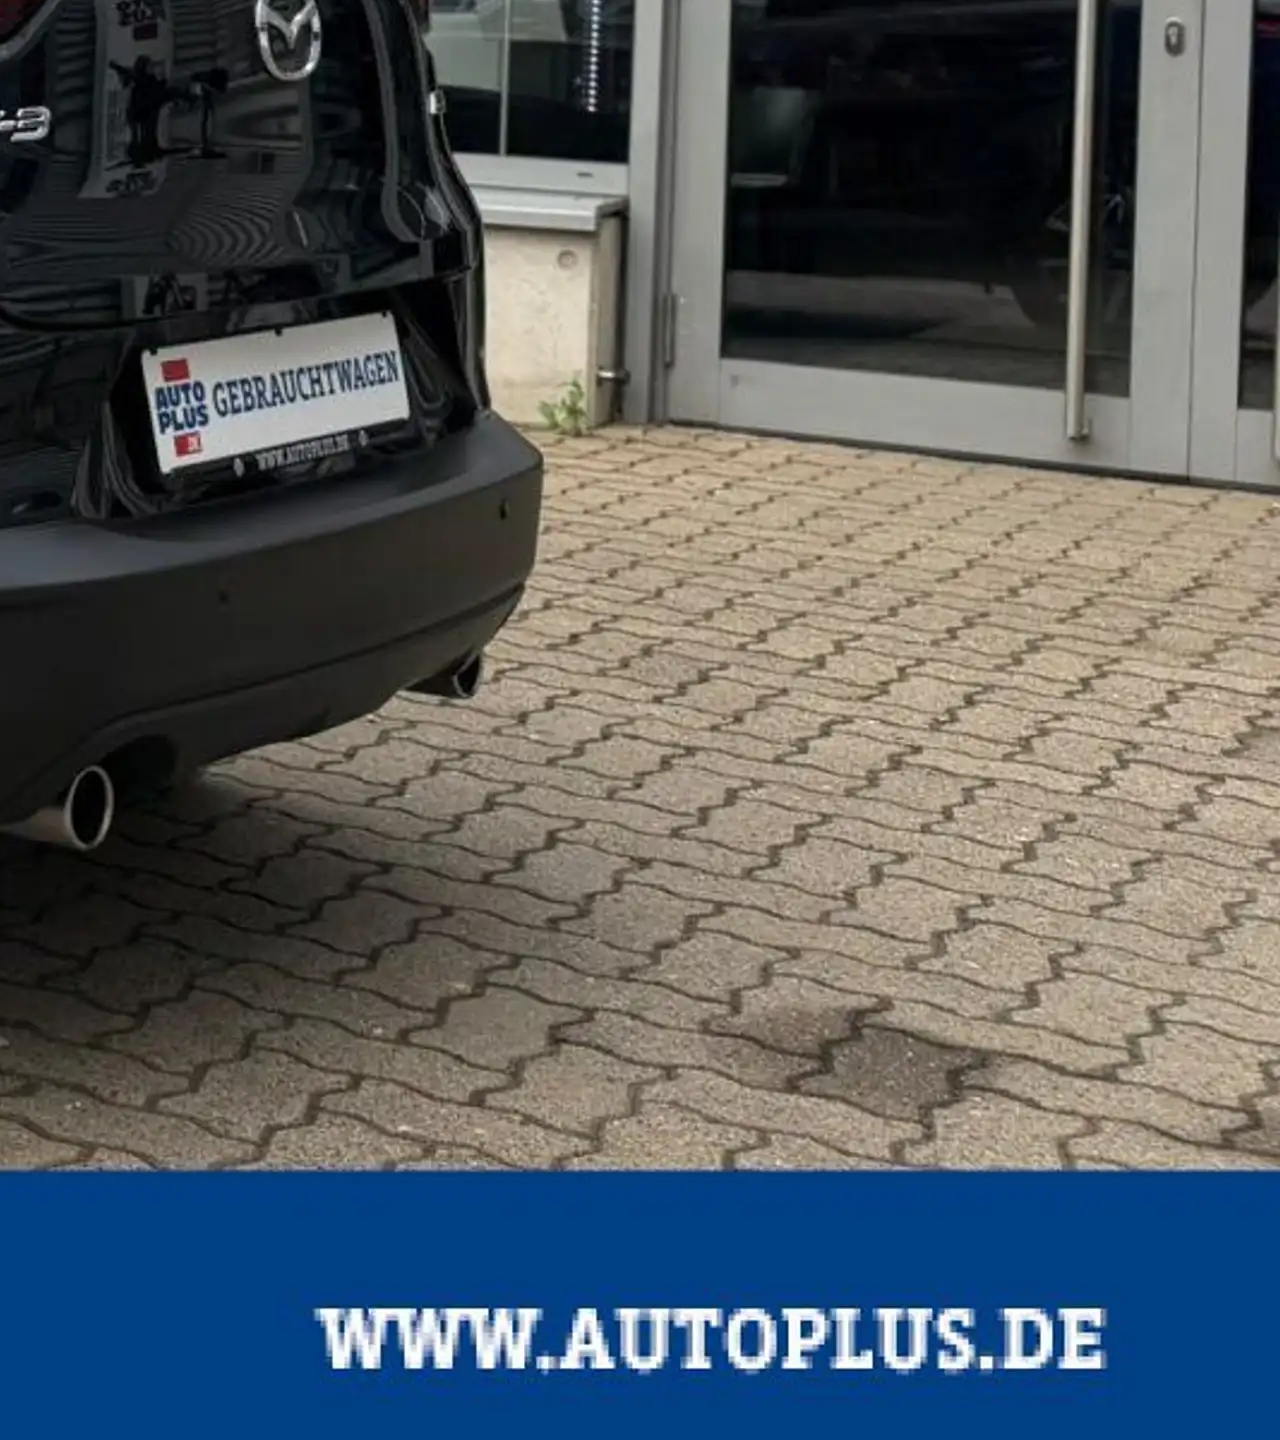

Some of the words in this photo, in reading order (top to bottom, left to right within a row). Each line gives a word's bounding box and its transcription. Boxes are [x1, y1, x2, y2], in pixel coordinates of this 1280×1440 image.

[155, 381, 206, 411] AUTO
[212, 350, 400, 418] GEBRAUCHTWAGEN
[157, 404, 210, 435] PLUS
